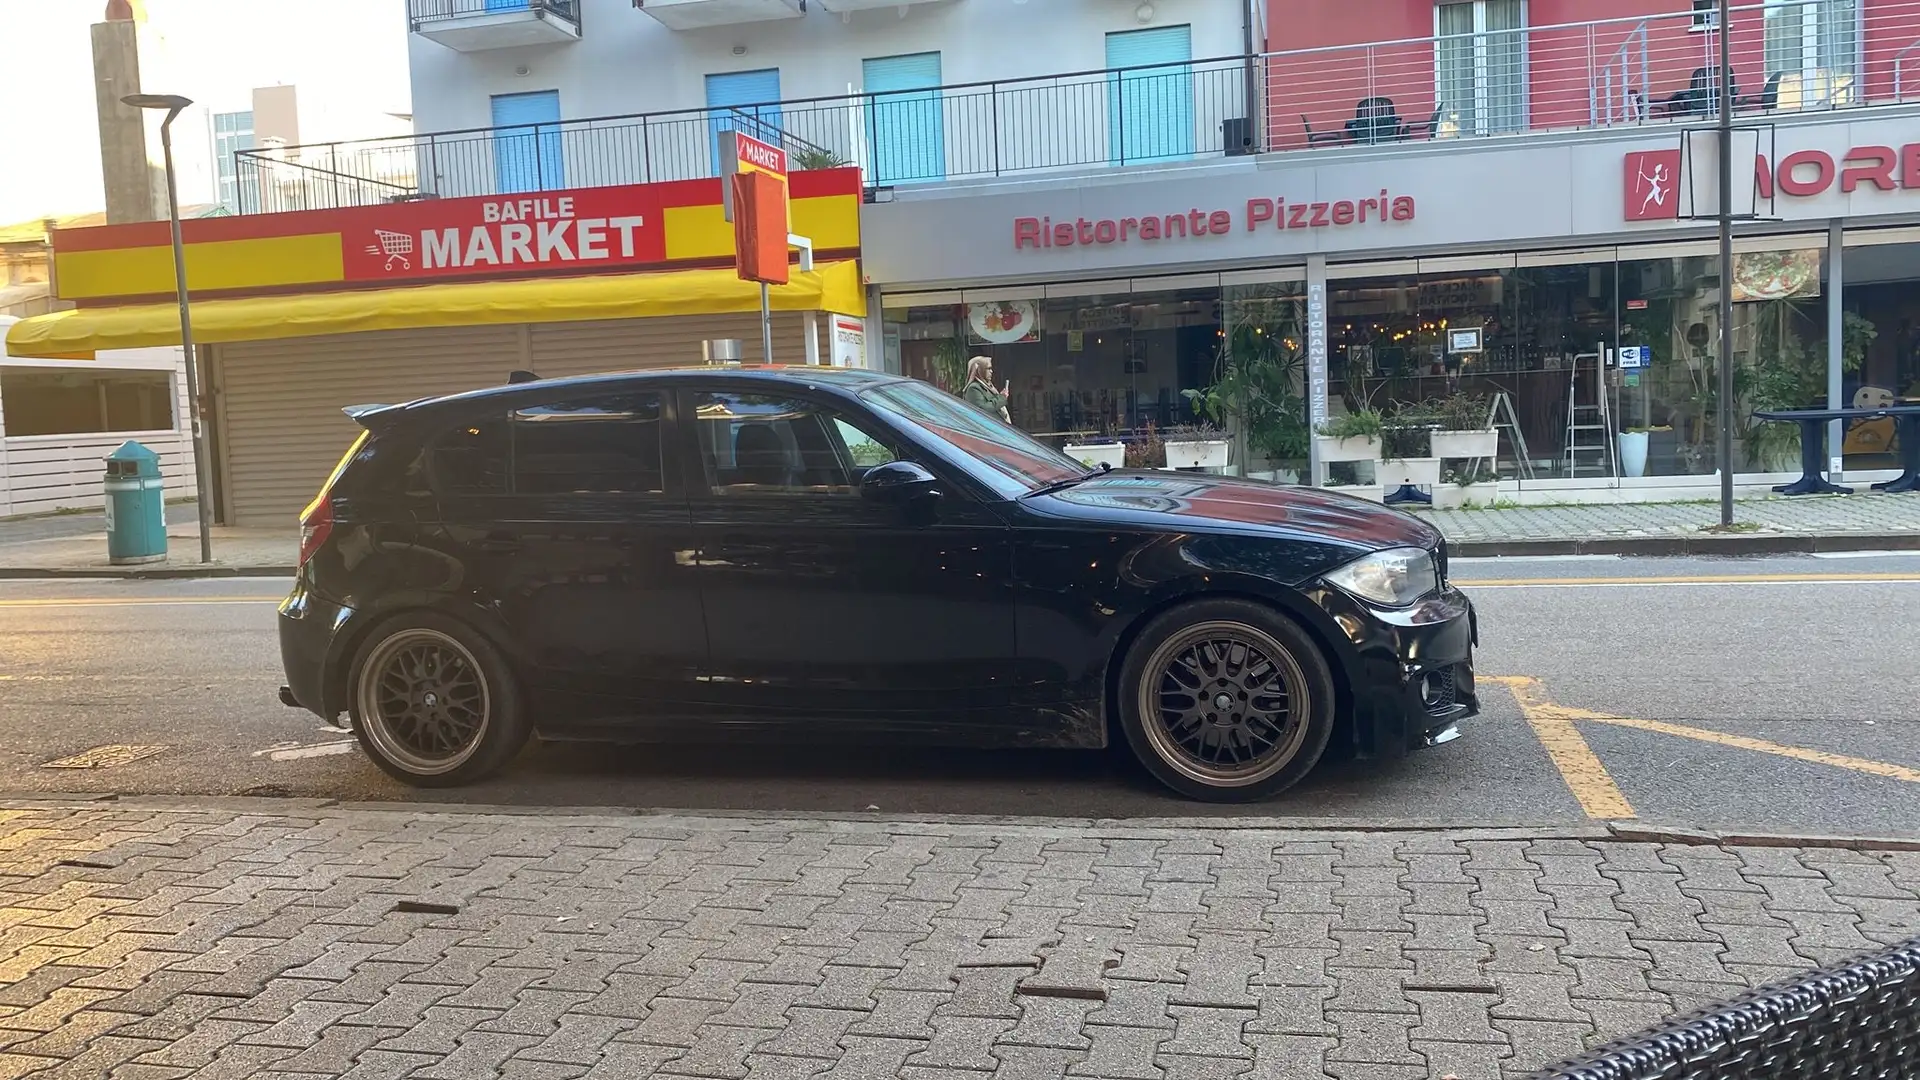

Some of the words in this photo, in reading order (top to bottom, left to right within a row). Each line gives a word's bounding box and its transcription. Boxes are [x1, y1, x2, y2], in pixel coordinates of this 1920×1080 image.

[746, 141, 779, 170] MARKET
[1755, 143, 1920, 199] OR
[483, 197, 575, 223] BAFILE
[1014, 207, 1231, 249] Ristorante
[1247, 189, 1415, 232] Pizzeria
[421, 215, 643, 269] MARKET
[1310, 285, 1324, 373] RISTORANTE
